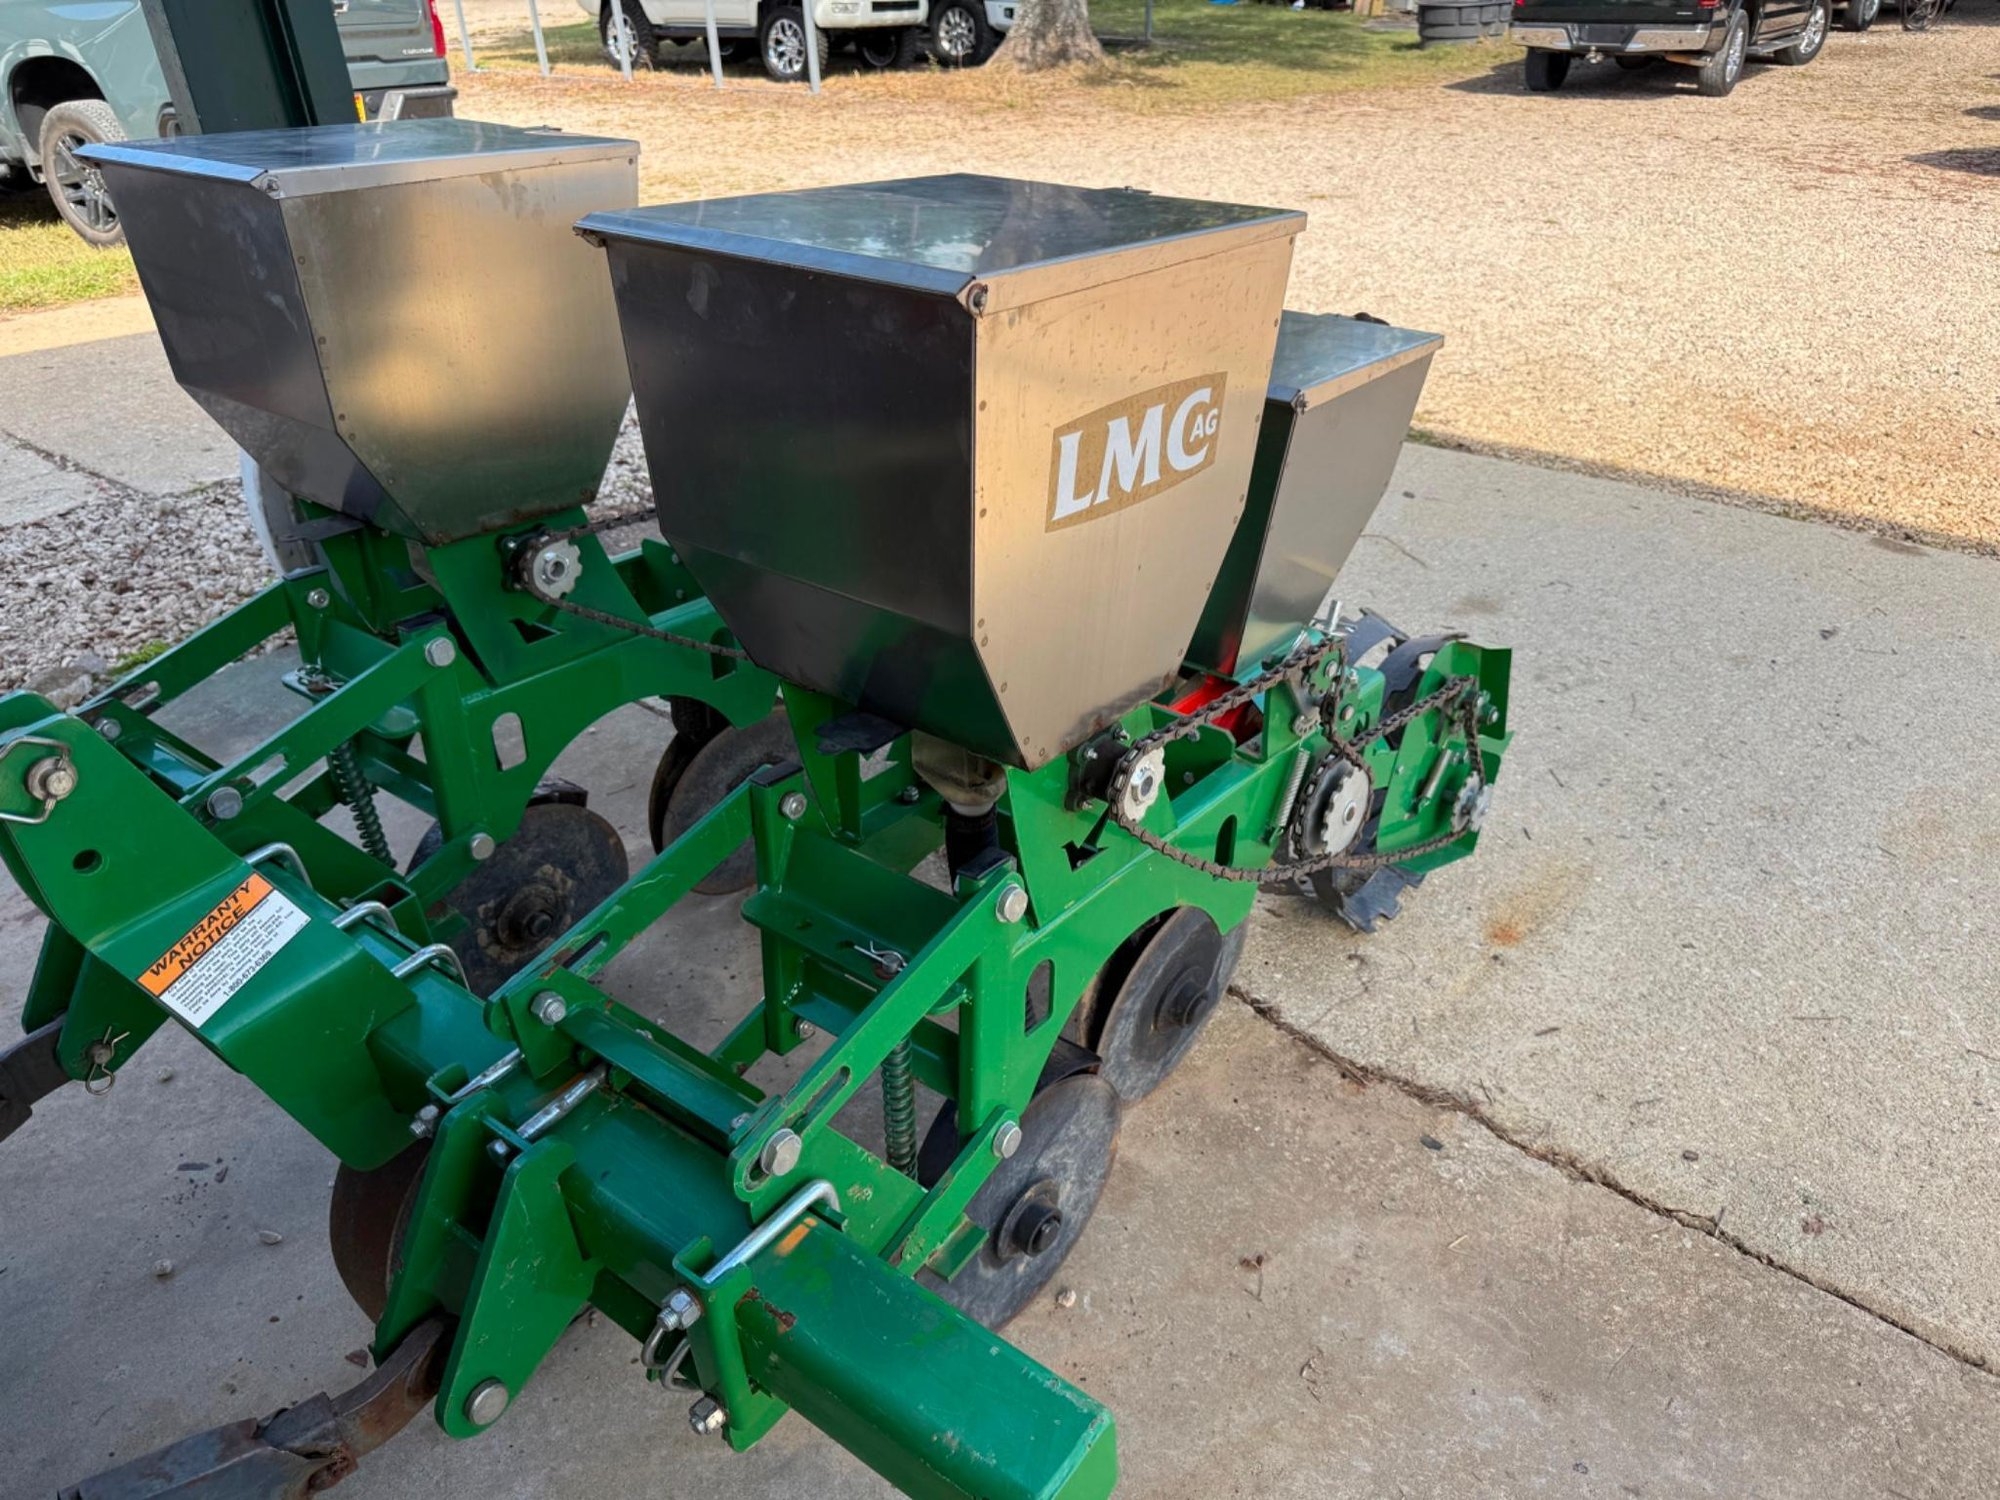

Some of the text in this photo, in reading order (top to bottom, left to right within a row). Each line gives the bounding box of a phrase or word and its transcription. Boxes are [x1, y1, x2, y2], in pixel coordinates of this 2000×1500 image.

[1052, 387, 1219, 521] LMC AG
[149, 880, 252, 977] WARRANTY
[178, 904, 247, 970] NOTICE
